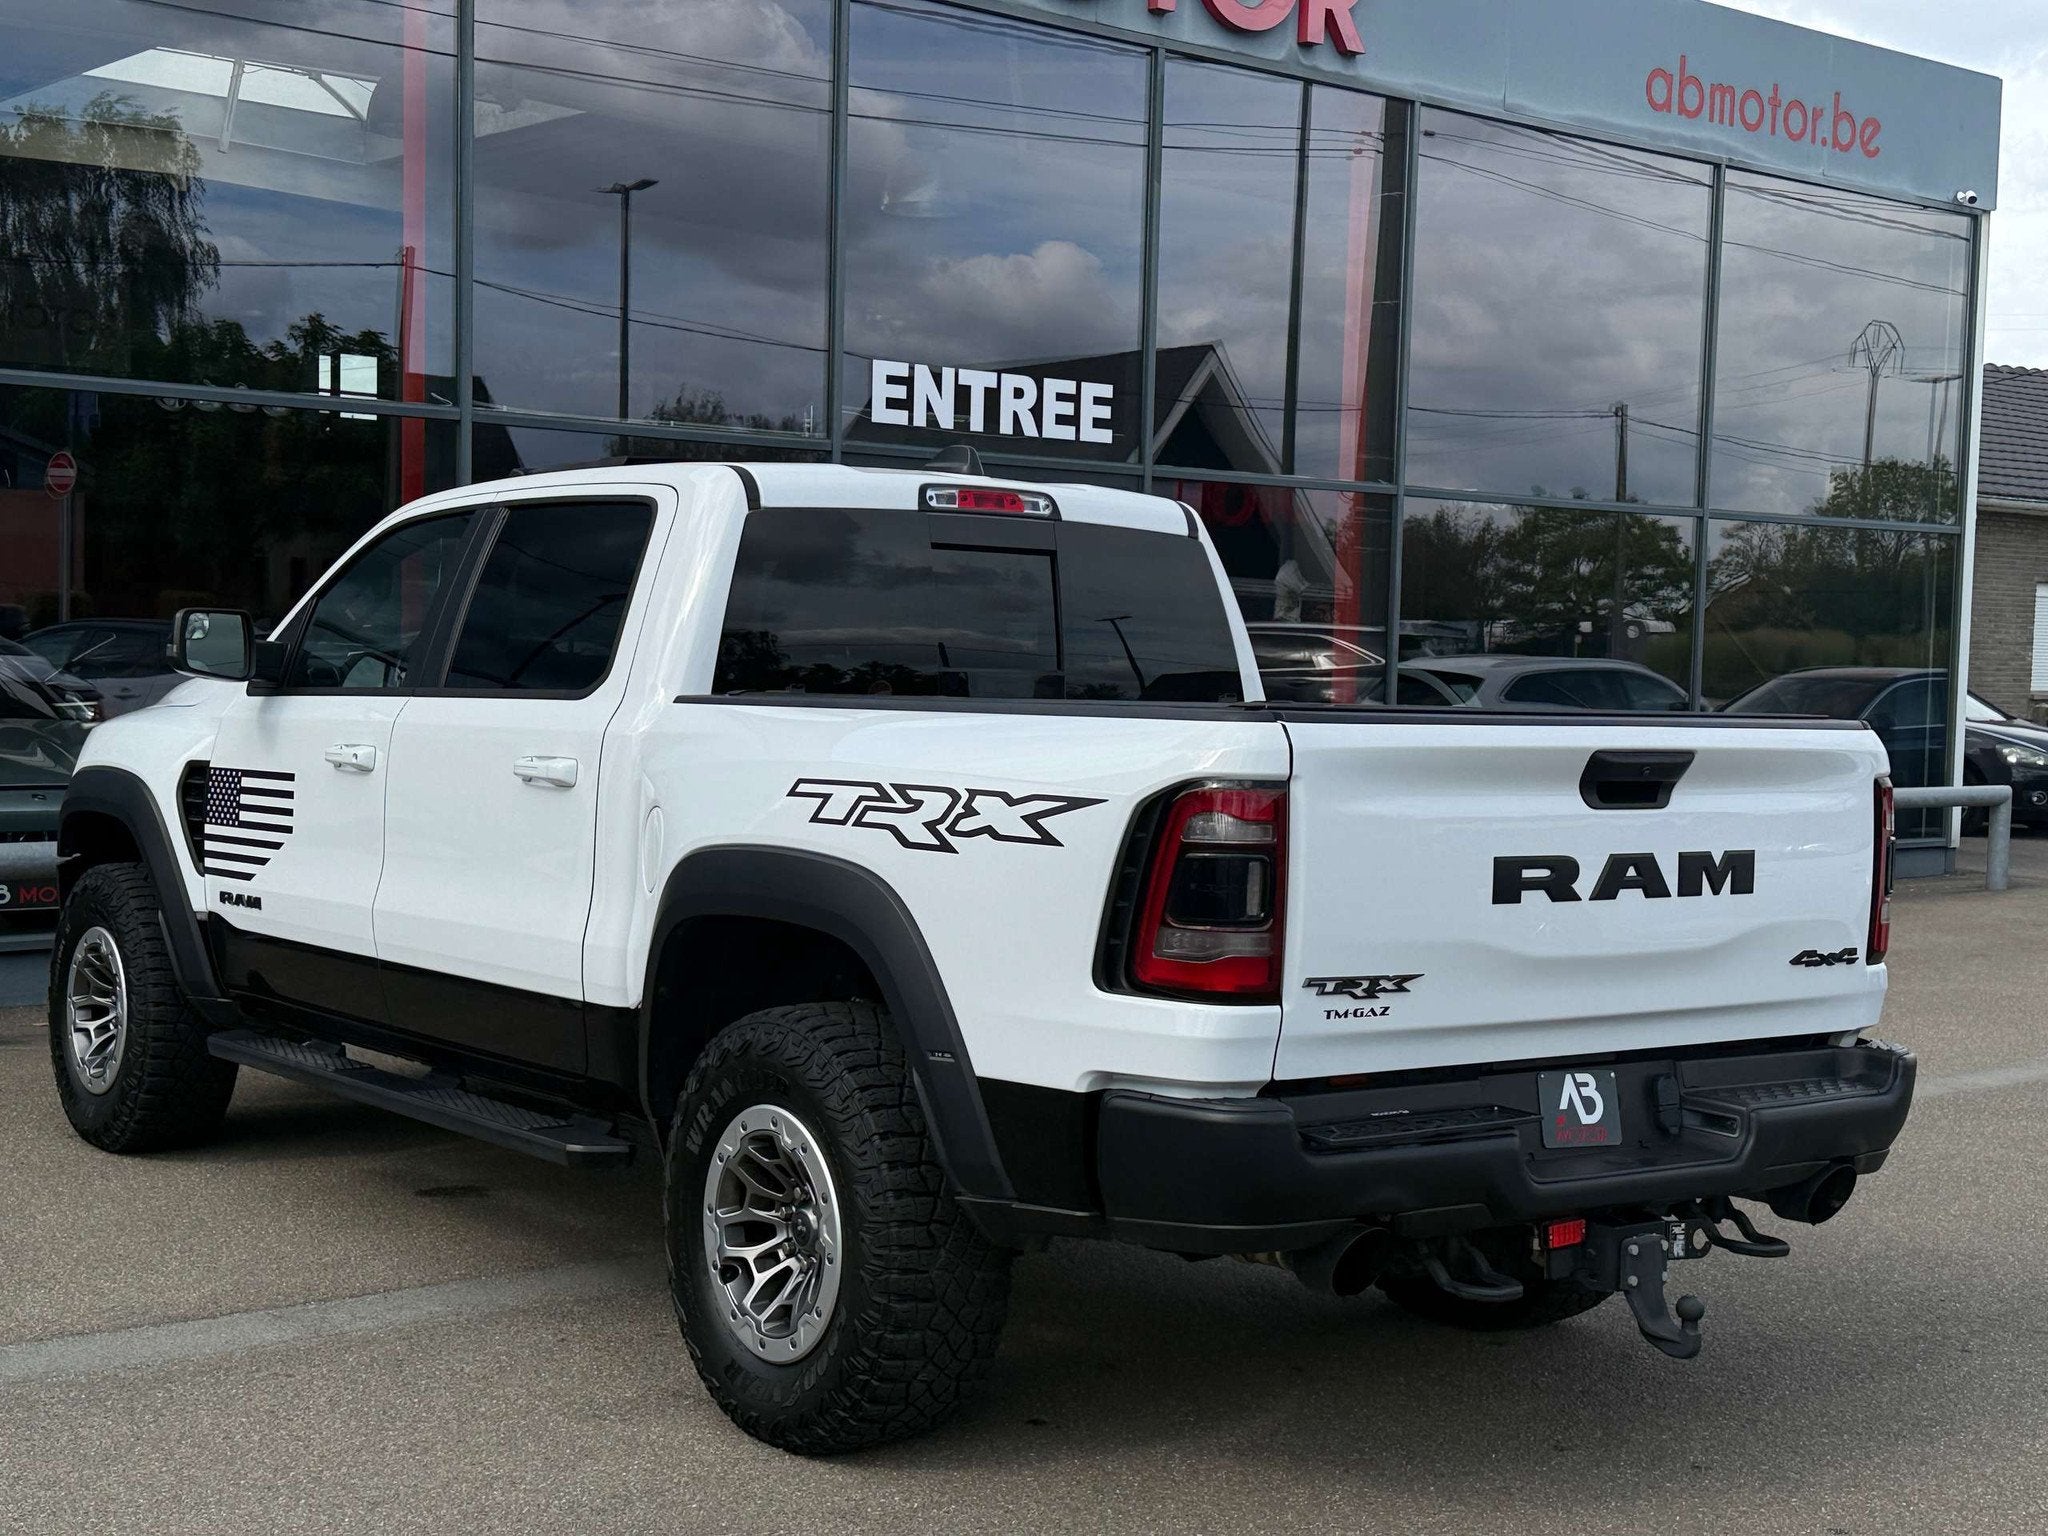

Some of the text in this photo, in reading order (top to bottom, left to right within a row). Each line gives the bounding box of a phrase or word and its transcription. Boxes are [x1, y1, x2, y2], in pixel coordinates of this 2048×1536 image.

[1646, 55, 1881, 158] abmotor.be
[872, 359, 1114, 444] ENTREE
[786, 778, 1109, 854] TRX
[219, 891, 262, 911] RAM
[1492, 850, 1755, 904] RAM
[1302, 973, 1425, 1000] TRX
[1324, 1006, 1390, 1020] TM-GAZ
[1559, 1073, 1604, 1125] AB
